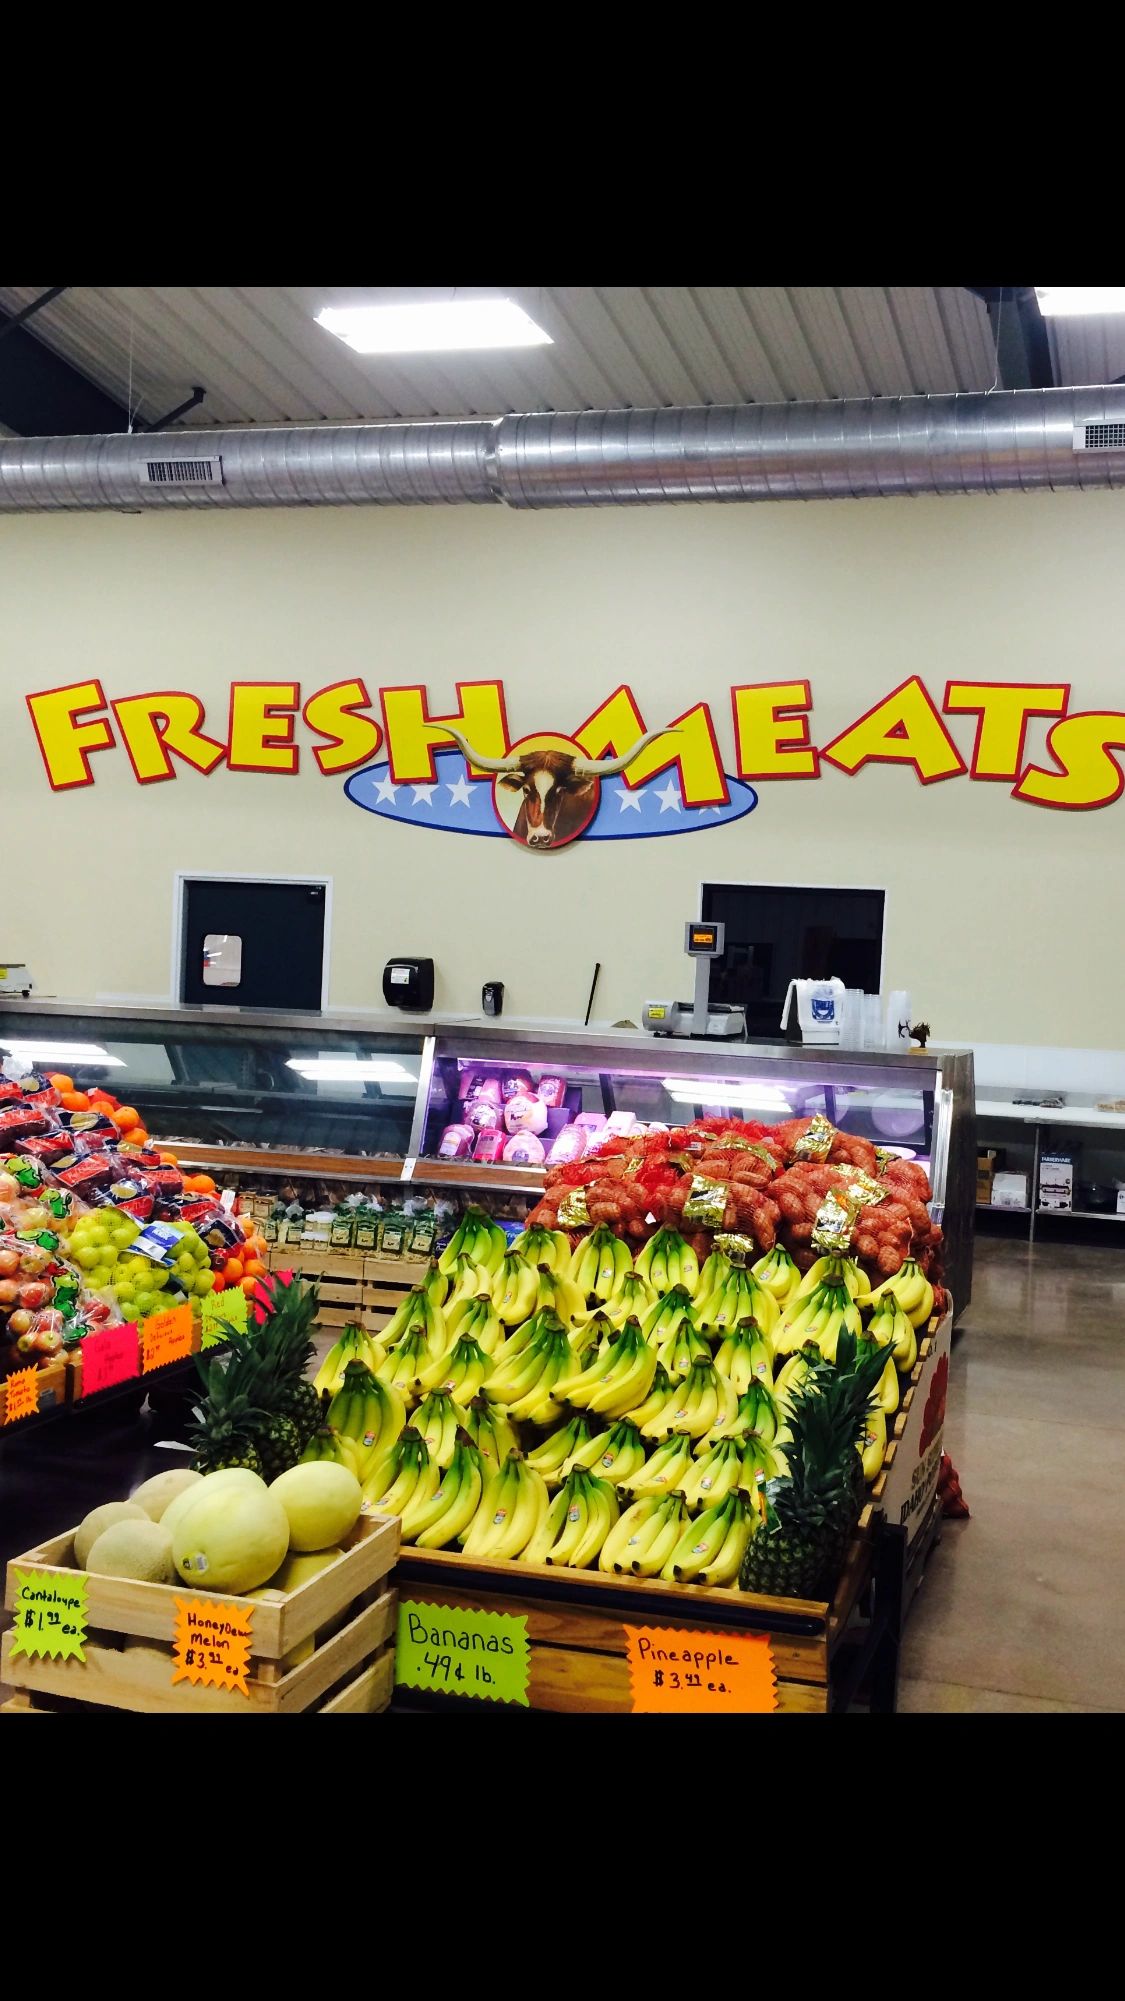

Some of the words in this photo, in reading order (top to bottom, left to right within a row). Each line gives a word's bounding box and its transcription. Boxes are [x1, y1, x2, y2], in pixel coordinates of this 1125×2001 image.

[26, 678, 512, 792] FRESH
[572, 675, 1125, 810] MEATS
[22, 1586, 80, 1610] Cantaloupe
[191, 1633, 230, 1650] Melon
[408, 1613, 514, 1655] Bananas
[638, 1637, 739, 1670] Pineapple
[476, 1664, 496, 1685] lb.
